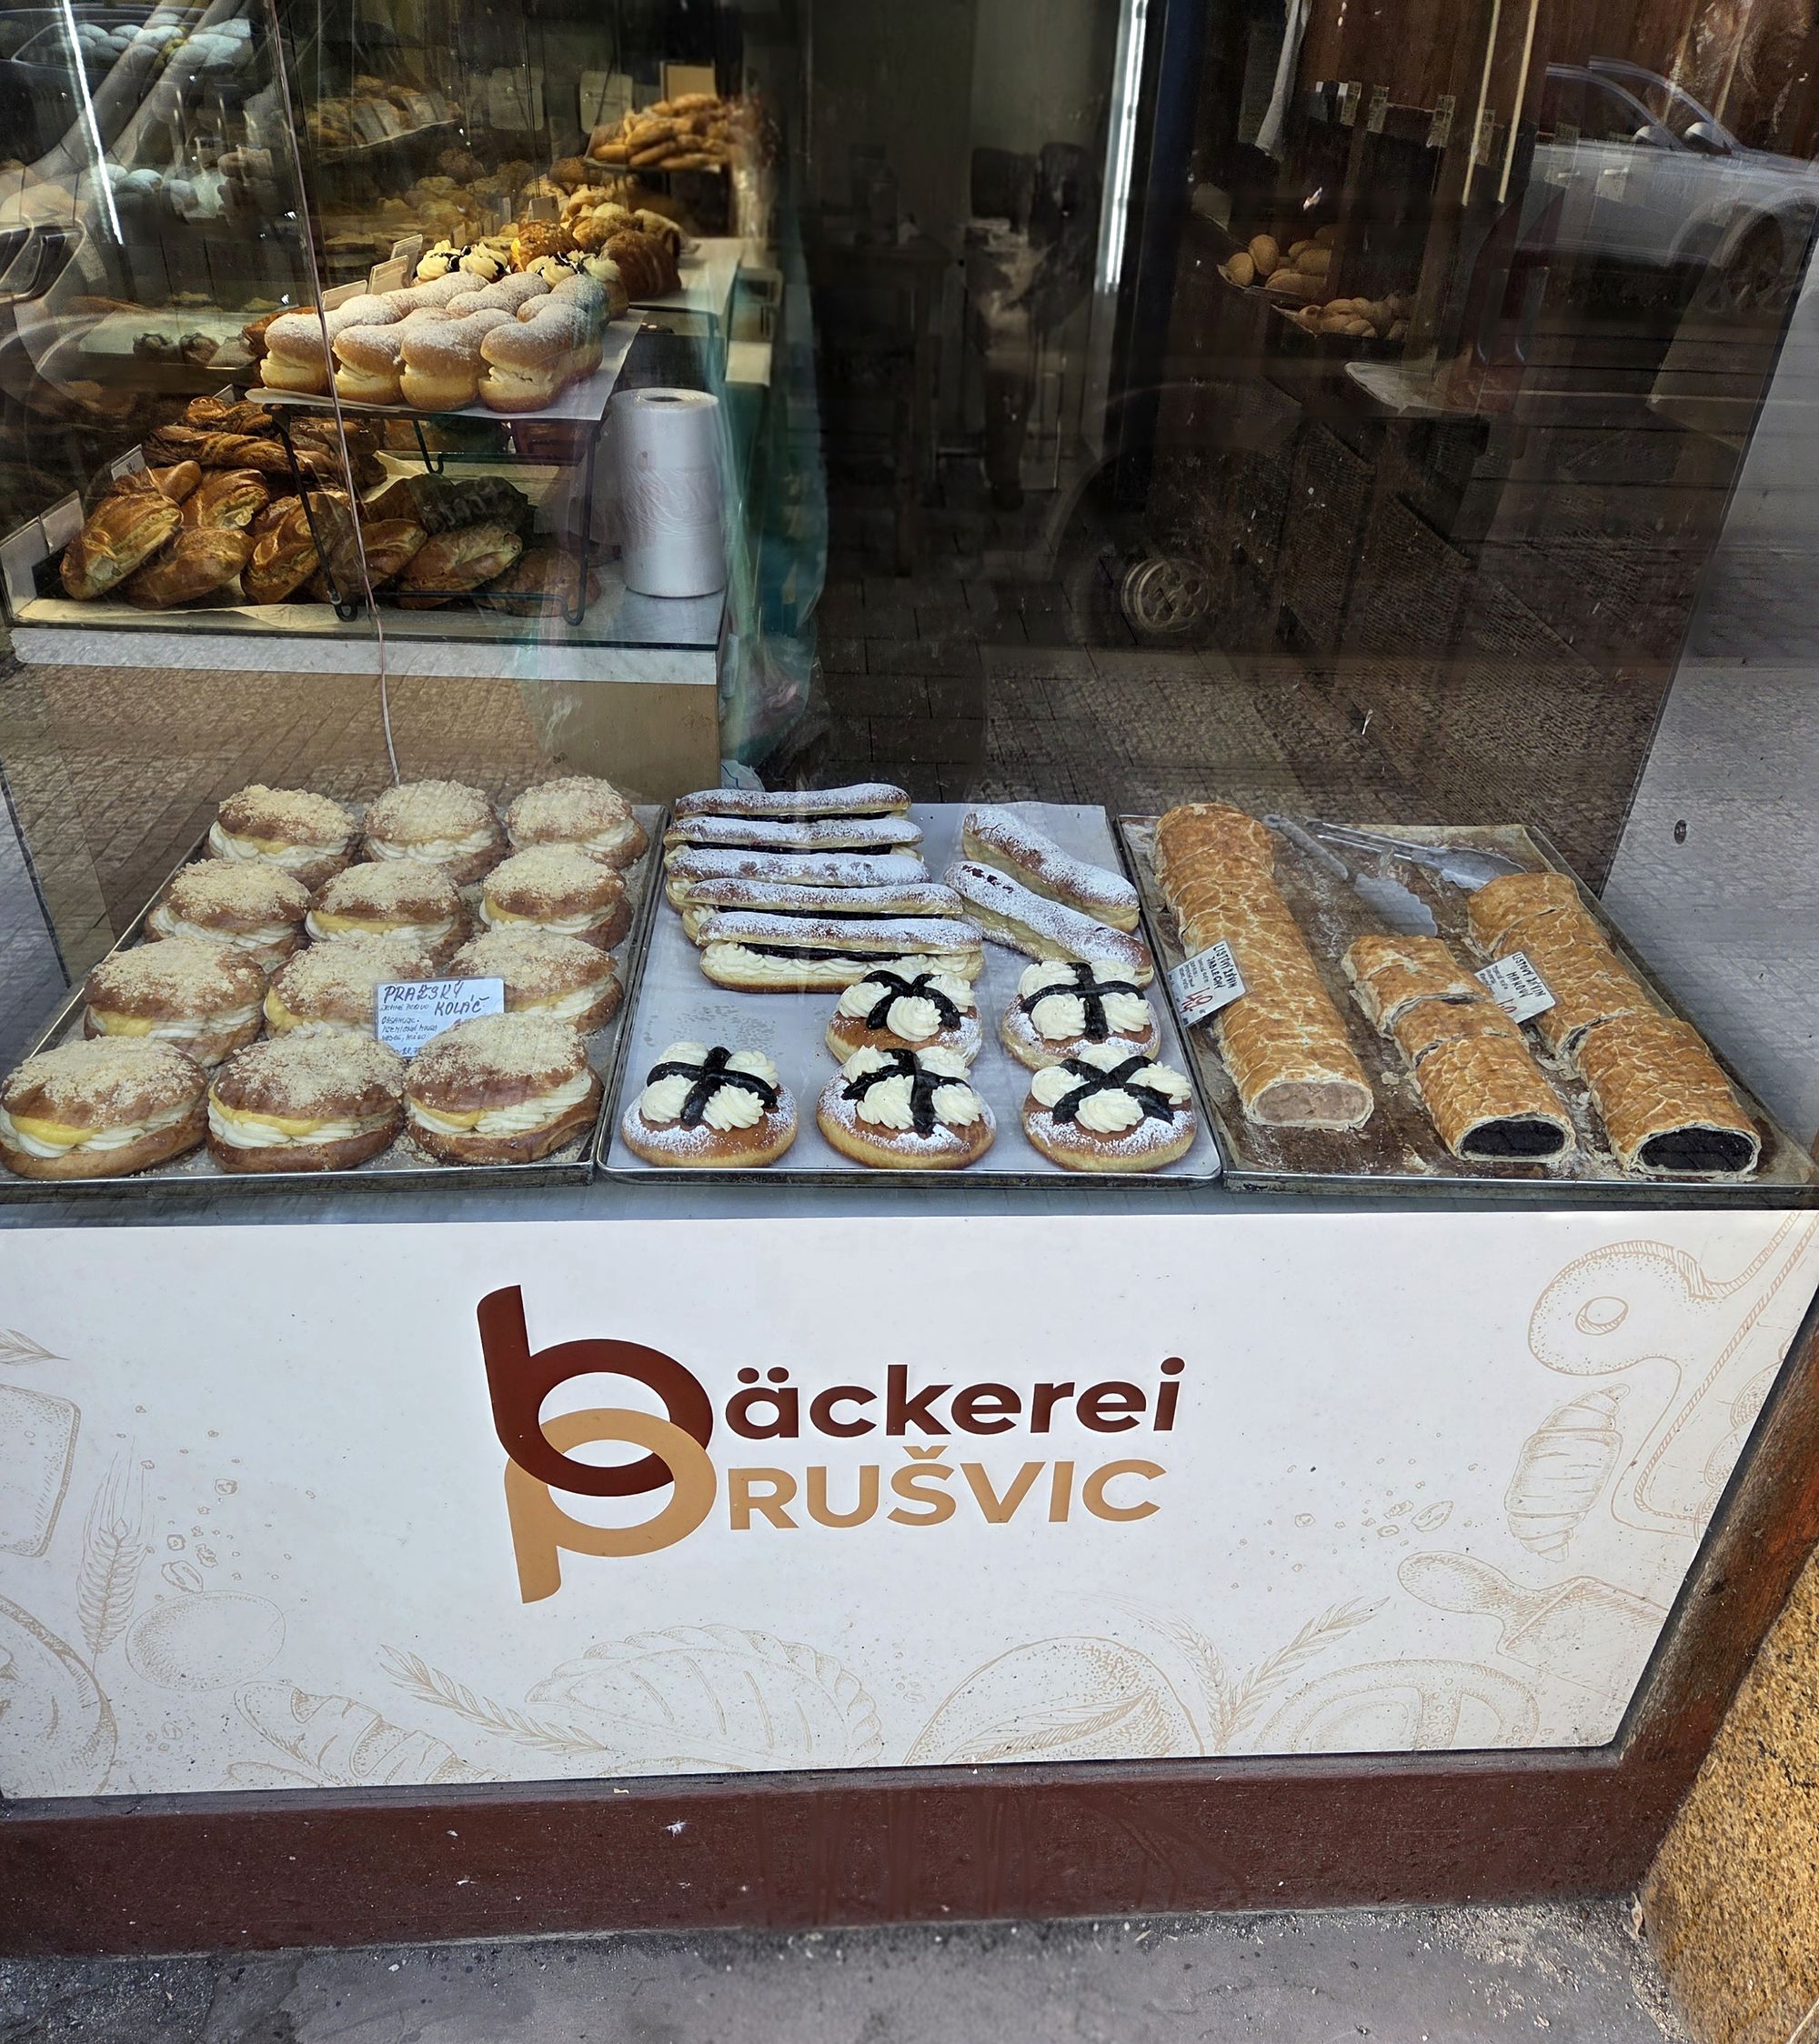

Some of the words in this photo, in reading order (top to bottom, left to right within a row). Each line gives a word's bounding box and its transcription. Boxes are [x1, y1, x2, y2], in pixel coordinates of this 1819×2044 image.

[384, 980, 464, 1003] PRAŽSKÝ
[434, 995, 490, 1017] KOLÁČ
[477, 1285, 1185, 1497] bäckerei
